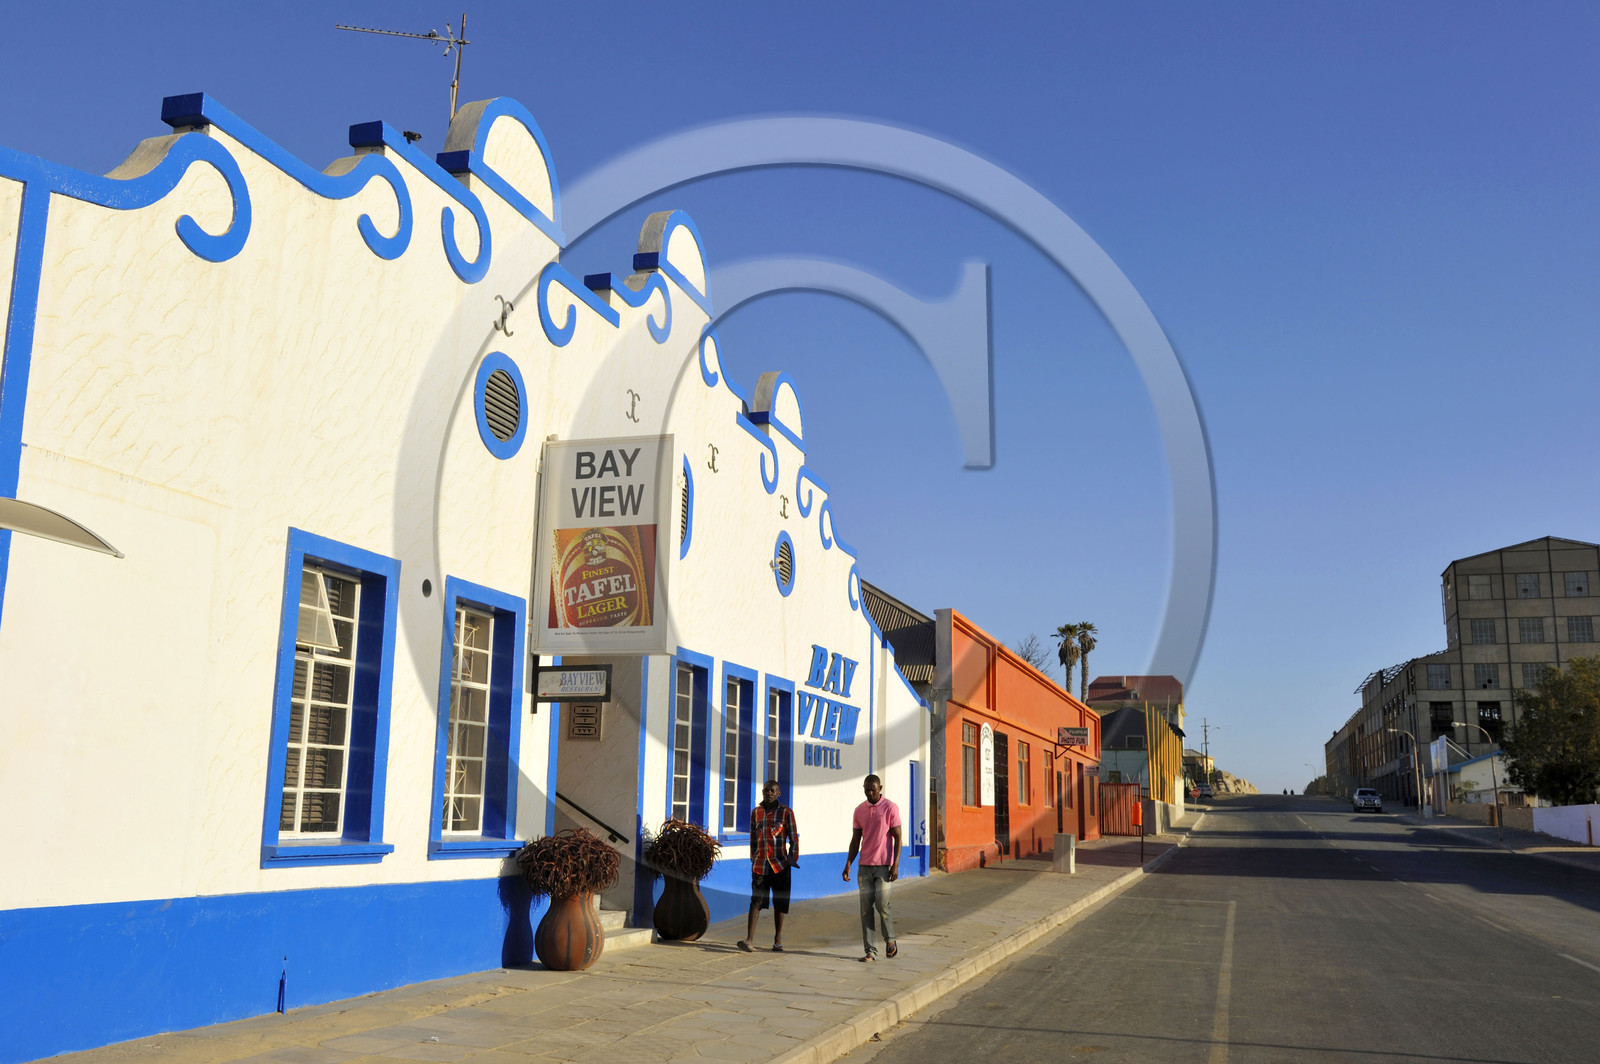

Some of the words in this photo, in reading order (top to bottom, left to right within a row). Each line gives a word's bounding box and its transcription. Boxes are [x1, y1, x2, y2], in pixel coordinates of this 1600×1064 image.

[575, 447, 642, 480] BAY
[571, 483, 645, 519] VIEW
[584, 533, 602, 542] TAFEL
[582, 566, 615, 580] FINEST
[564, 574, 637, 607] TAFEL
[576, 596, 628, 620] LAGER
[804, 644, 859, 698] BAY
[797, 690, 861, 746] VIEW
[804, 743, 842, 771] HOTEL
